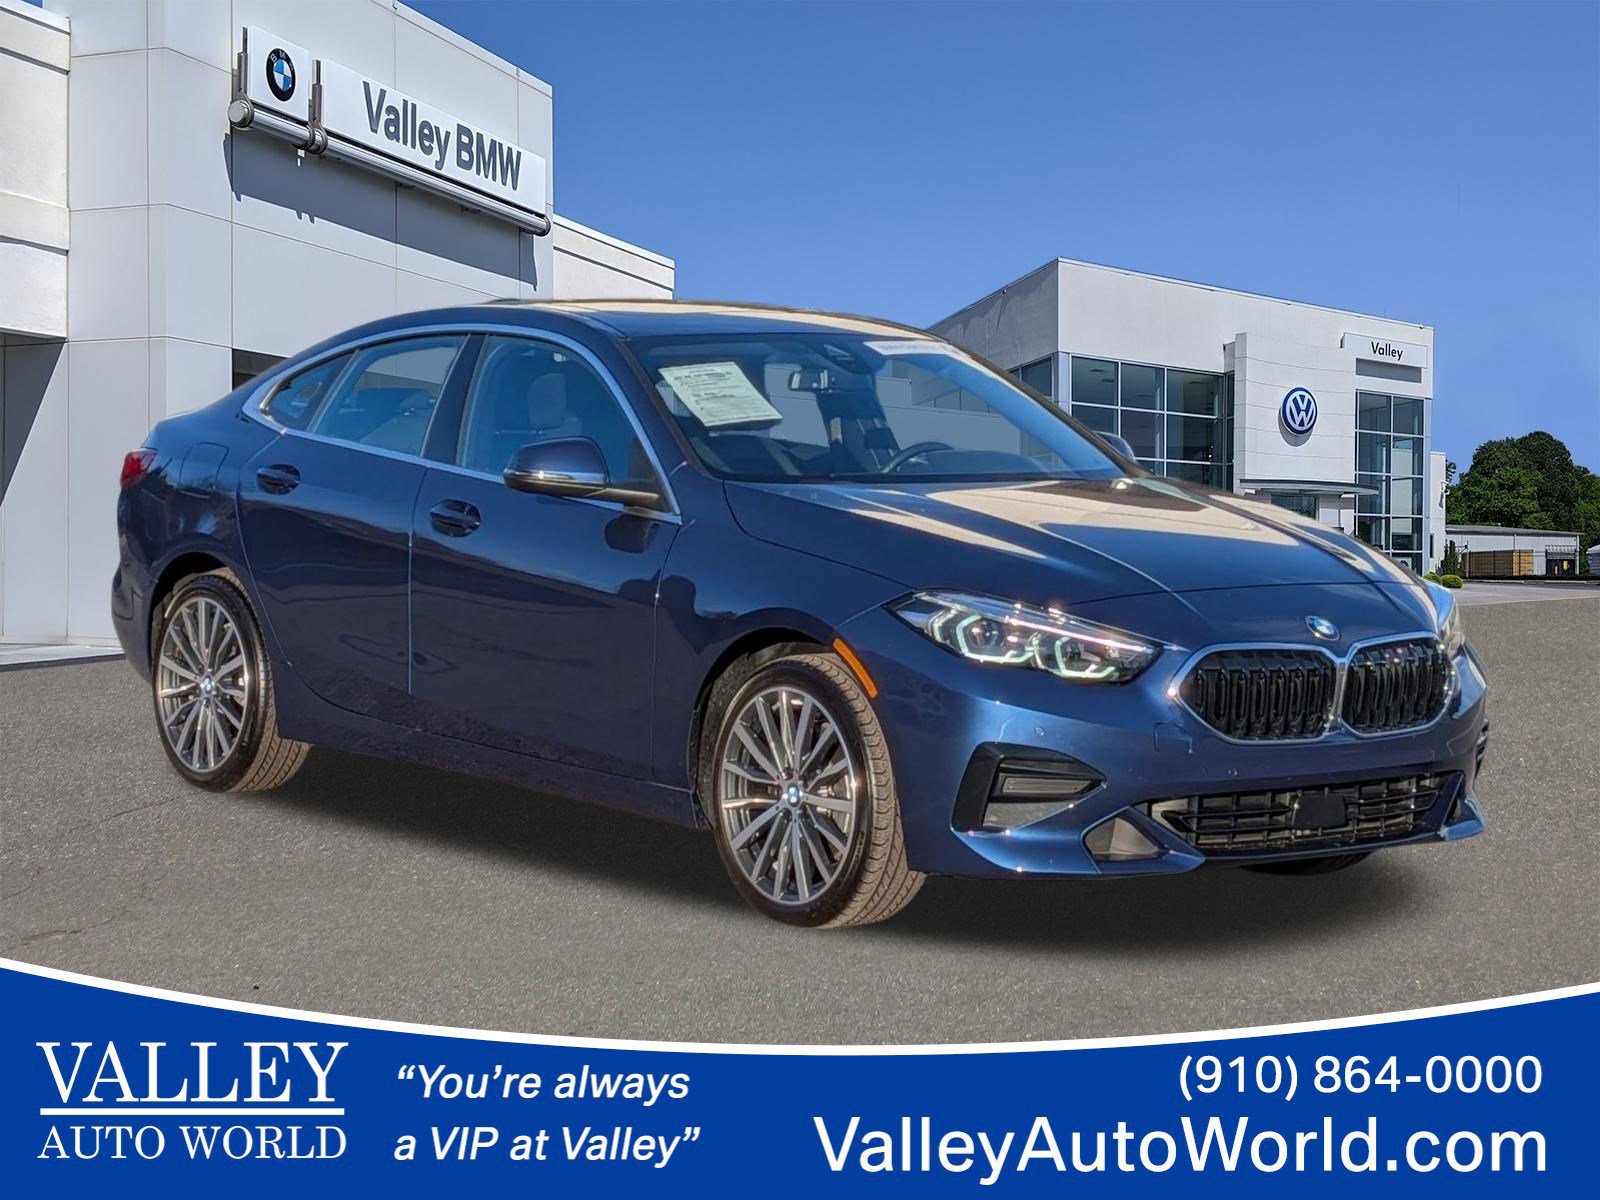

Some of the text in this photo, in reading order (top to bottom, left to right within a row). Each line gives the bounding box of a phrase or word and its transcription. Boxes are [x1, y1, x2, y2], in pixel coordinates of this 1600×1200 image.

[362, 80, 522, 192] Valley BMW
[1371, 341, 1404, 361] Valley
